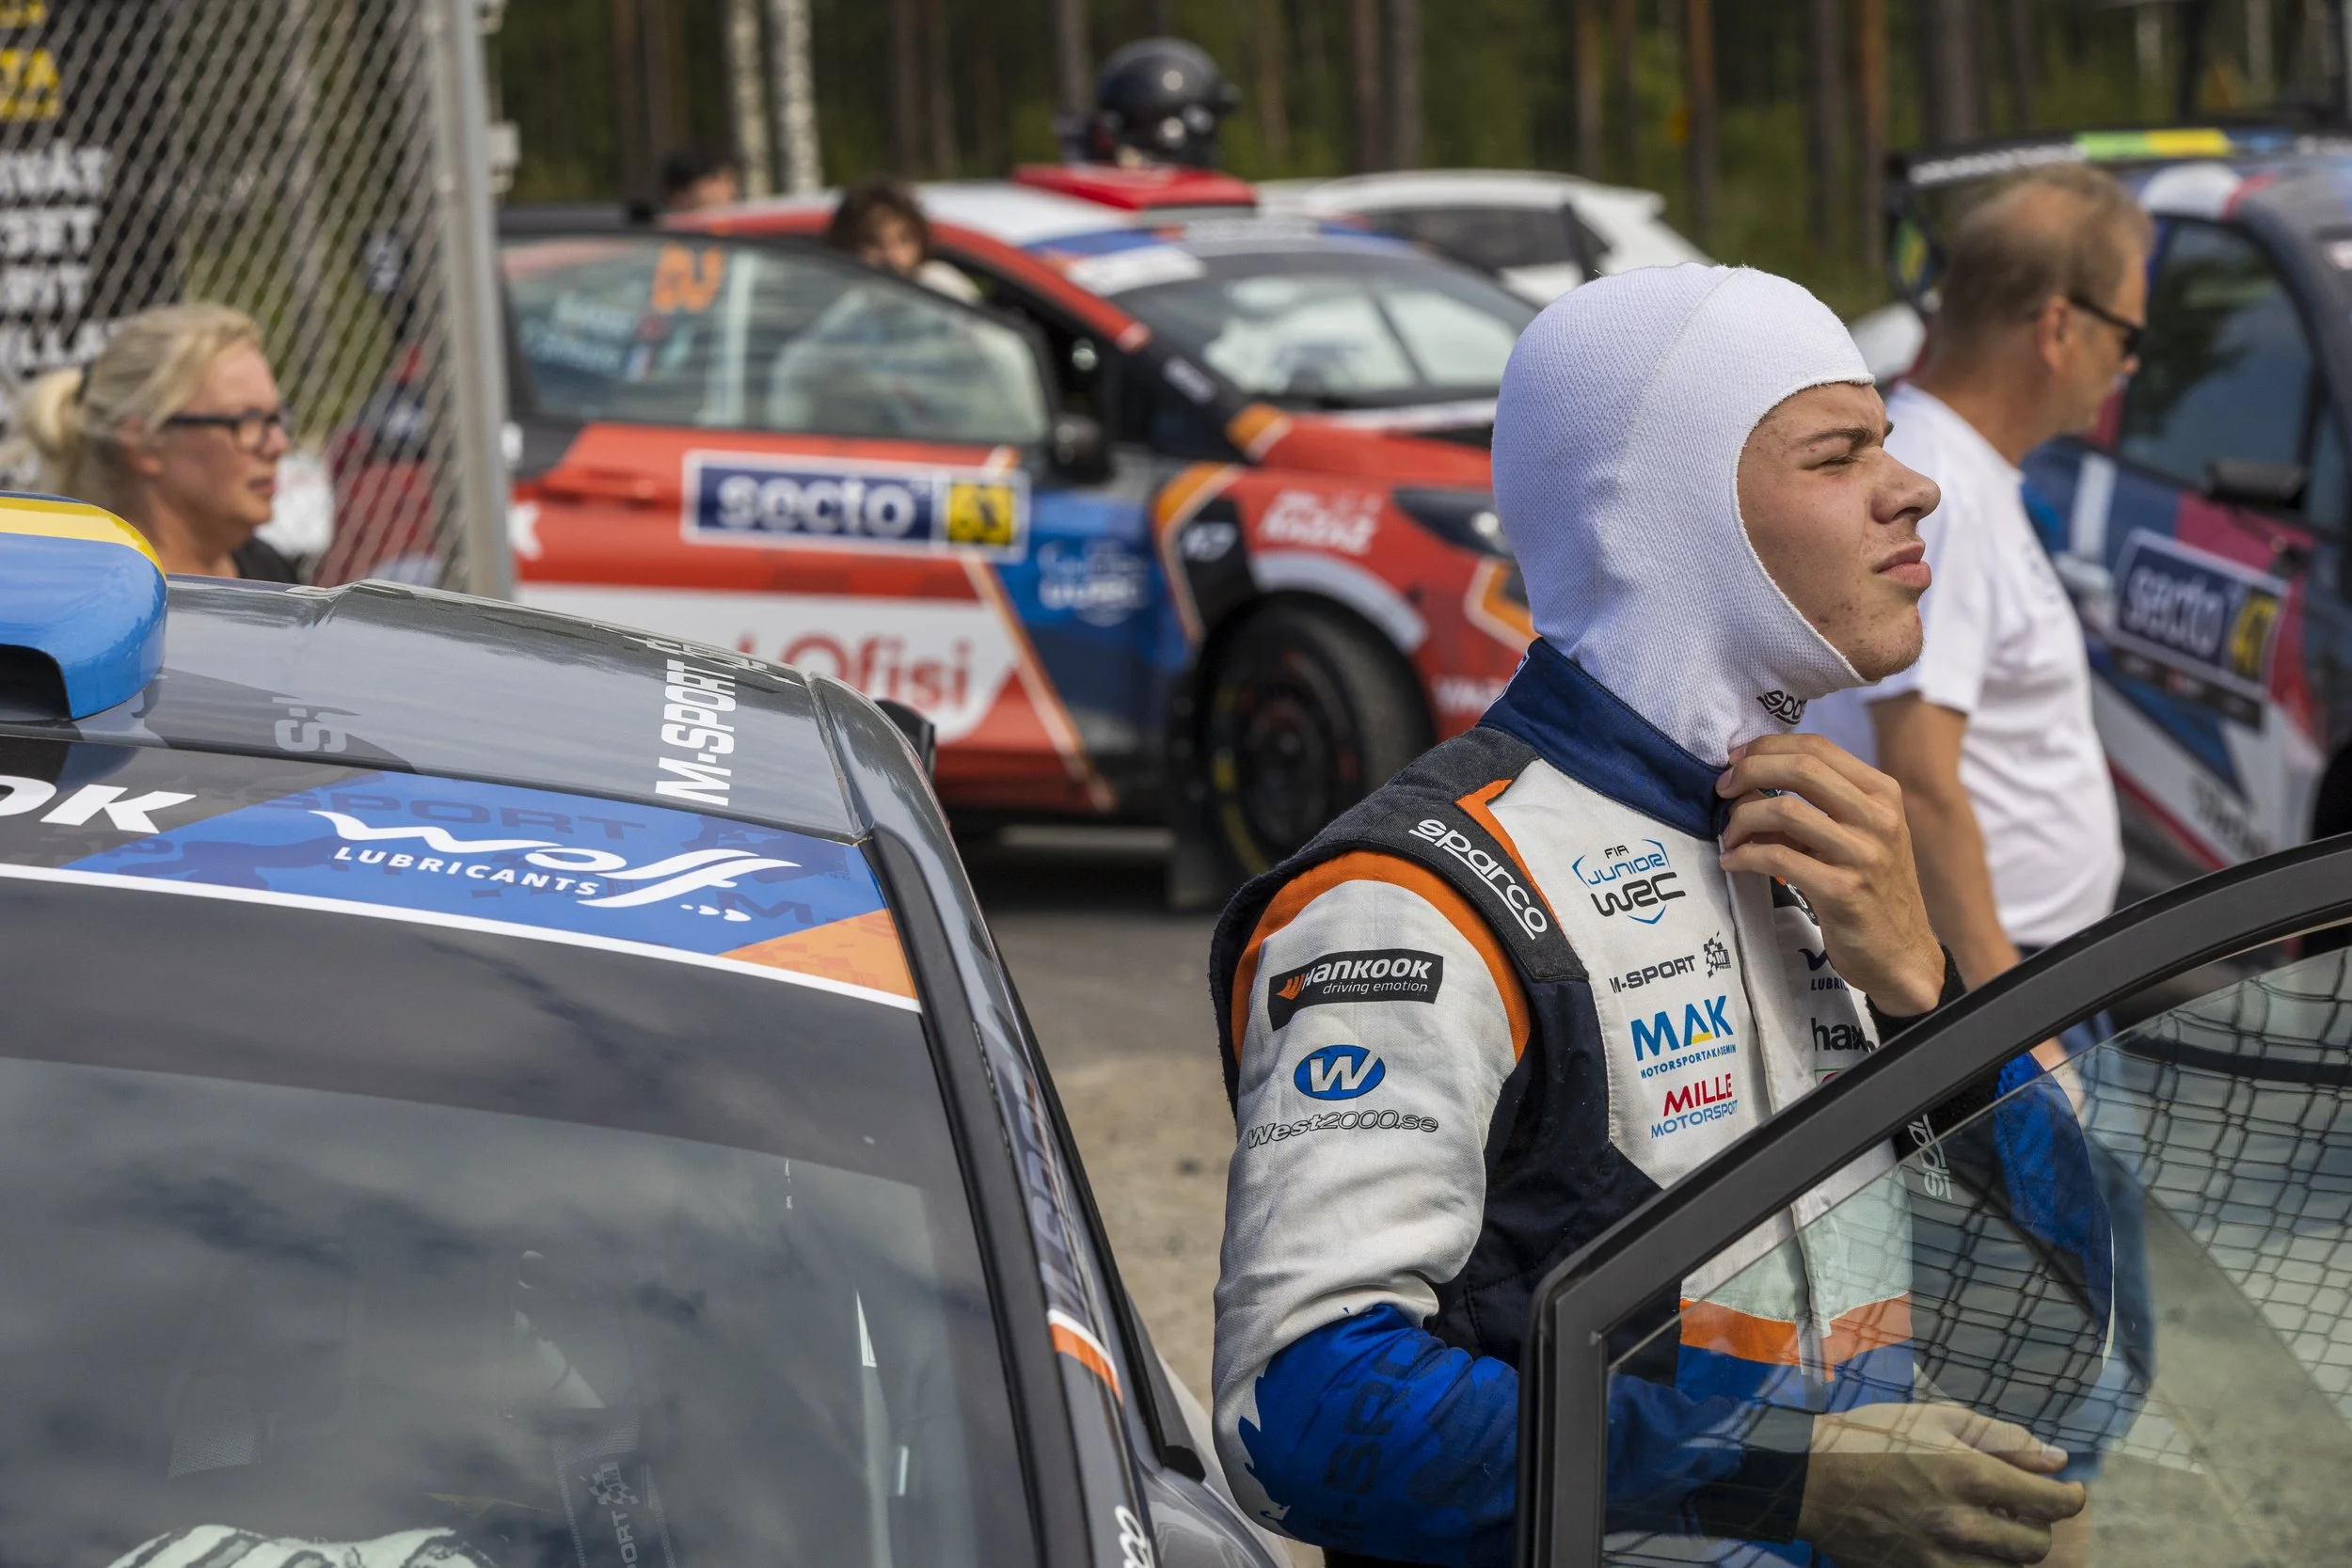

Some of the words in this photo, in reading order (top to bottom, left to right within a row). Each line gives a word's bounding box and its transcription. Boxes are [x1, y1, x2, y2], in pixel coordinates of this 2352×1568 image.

[717, 473, 916, 539] secto
[655, 659, 737, 806] M-SPORT
[333, 847, 600, 897] LUBRICANTS
[1586, 852, 1667, 885] JUNIOR
[1604, 844, 1629, 860] FIA
[1408, 817, 1548, 941] sparco
[1590, 871, 1687, 918] WRC
[1322, 981, 1370, 996] driving
[1373, 979, 1429, 993] emotion
[1609, 954, 1696, 994] M-SPORT
[1629, 994, 1735, 1062] MAK
[1309, 1051, 1383, 1094] W
[1640, 1043, 1738, 1080] MOTORSPORTAKADEMIN
[1663, 1072, 1733, 1117] MILLE
[1247, 1108, 1439, 1149] West2000.se
[1650, 1099, 1739, 1140] MOTORSPORT
